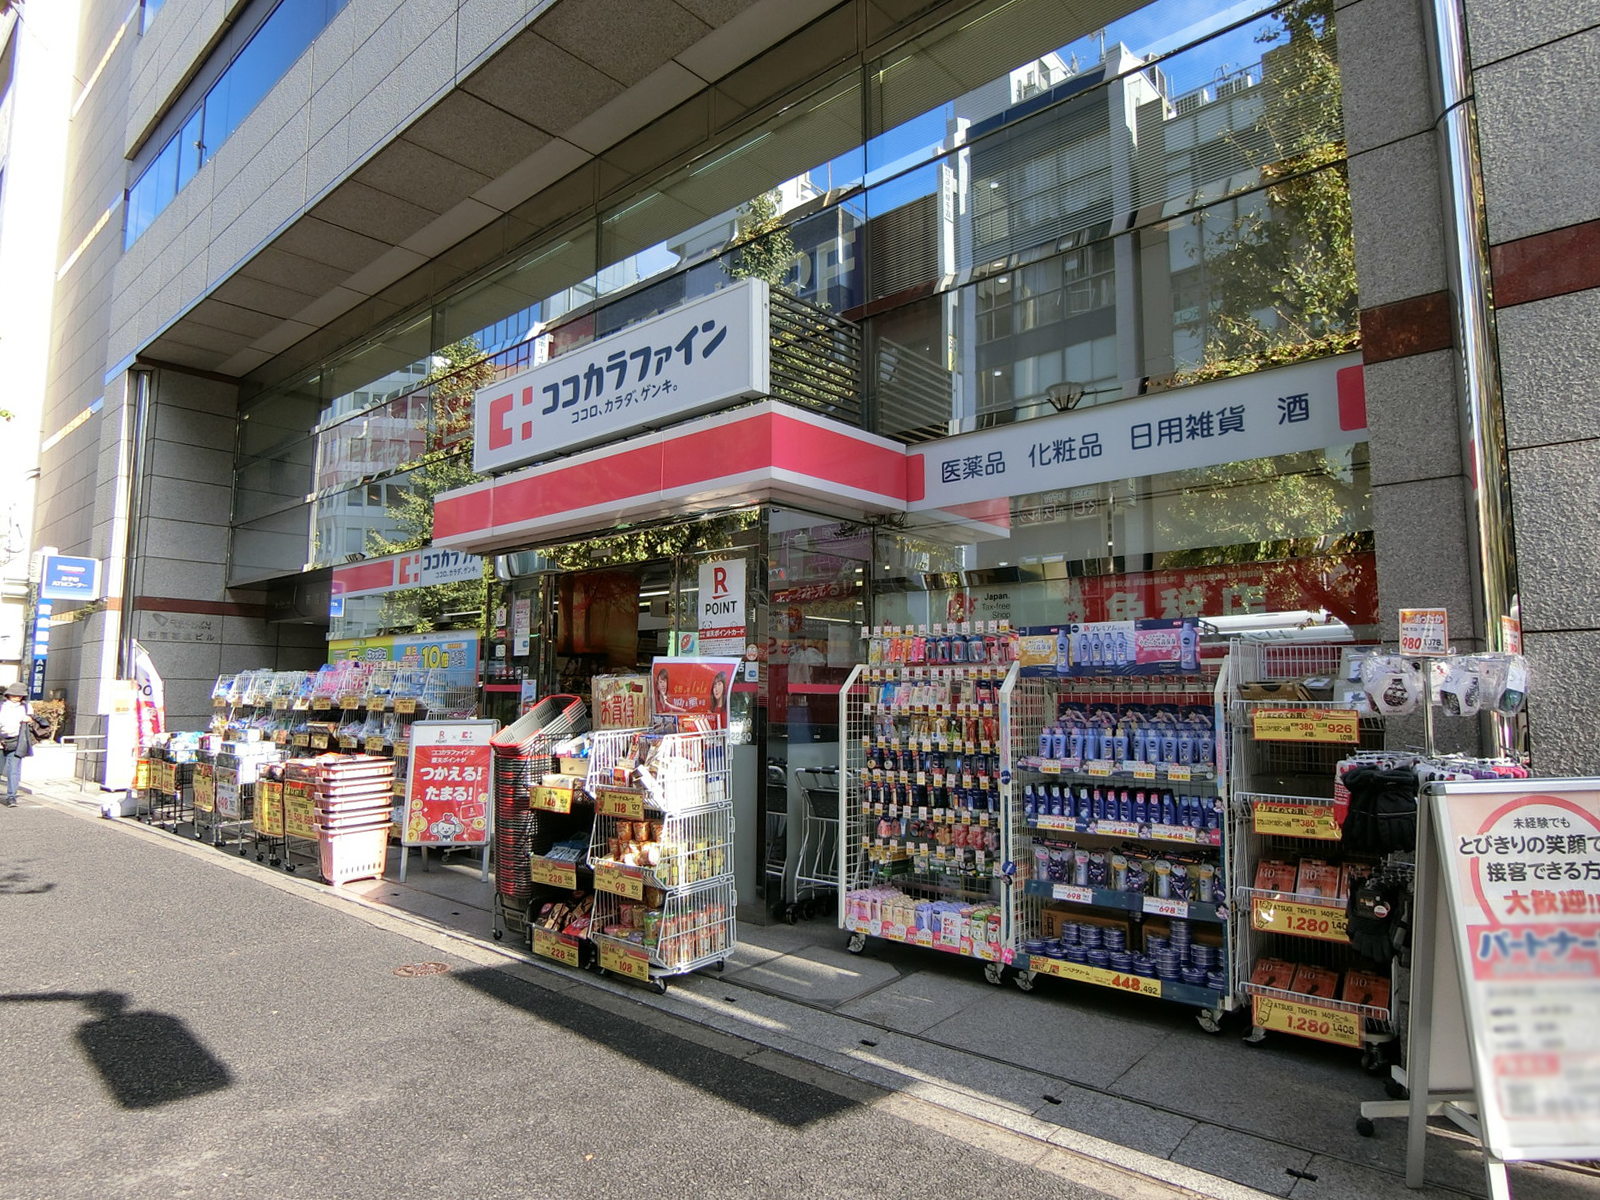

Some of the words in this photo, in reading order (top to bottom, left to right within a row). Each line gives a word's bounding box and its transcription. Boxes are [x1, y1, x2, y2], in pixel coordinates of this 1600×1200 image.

[542, 320, 727, 415] ココカラファイン
[572, 380, 677, 424] ココロ、カラダ、ゲンキ。
[941, 451, 1006, 483] 医薬品
[1028, 432, 1103, 468] 化粧品
[1130, 405, 1245, 450] 日用雑貨
[1277, 393, 1310, 426] 酒
[713, 566, 729, 594] R
[983, 592, 1011, 602] Japan.
[705, 600, 738, 615] POINT
[981, 602, 1011, 610] Tax-free
[992, 611, 1011, 619] Shop
[1402, 637, 1422, 650] 980
[1327, 724, 1352, 733] 926
[420, 766, 482, 781] つかえる!
[425, 786, 473, 801] たまる!
[614, 802, 626, 813] 118
[1300, 820, 1315, 828] 380
[1513, 817, 1571, 828] 未経験でも
[1487, 861, 1600, 882] 接客できる方
[549, 874, 562, 884] 228
[614, 882, 625, 893] 98
[1066, 892, 1081, 900] 698
[1158, 905, 1175, 914] 698
[1273, 905, 1293, 913] ATSUGI
[1297, 907, 1316, 916] TIGHTS
[551, 948, 565, 959] 228
[619, 961, 632, 973] 108
[1111, 974, 1140, 991] 448
[1143, 985, 1158, 994] 492
[1273, 1002, 1294, 1012] ATSUGI
[1297, 1006, 1317, 1016] TIGHTS
